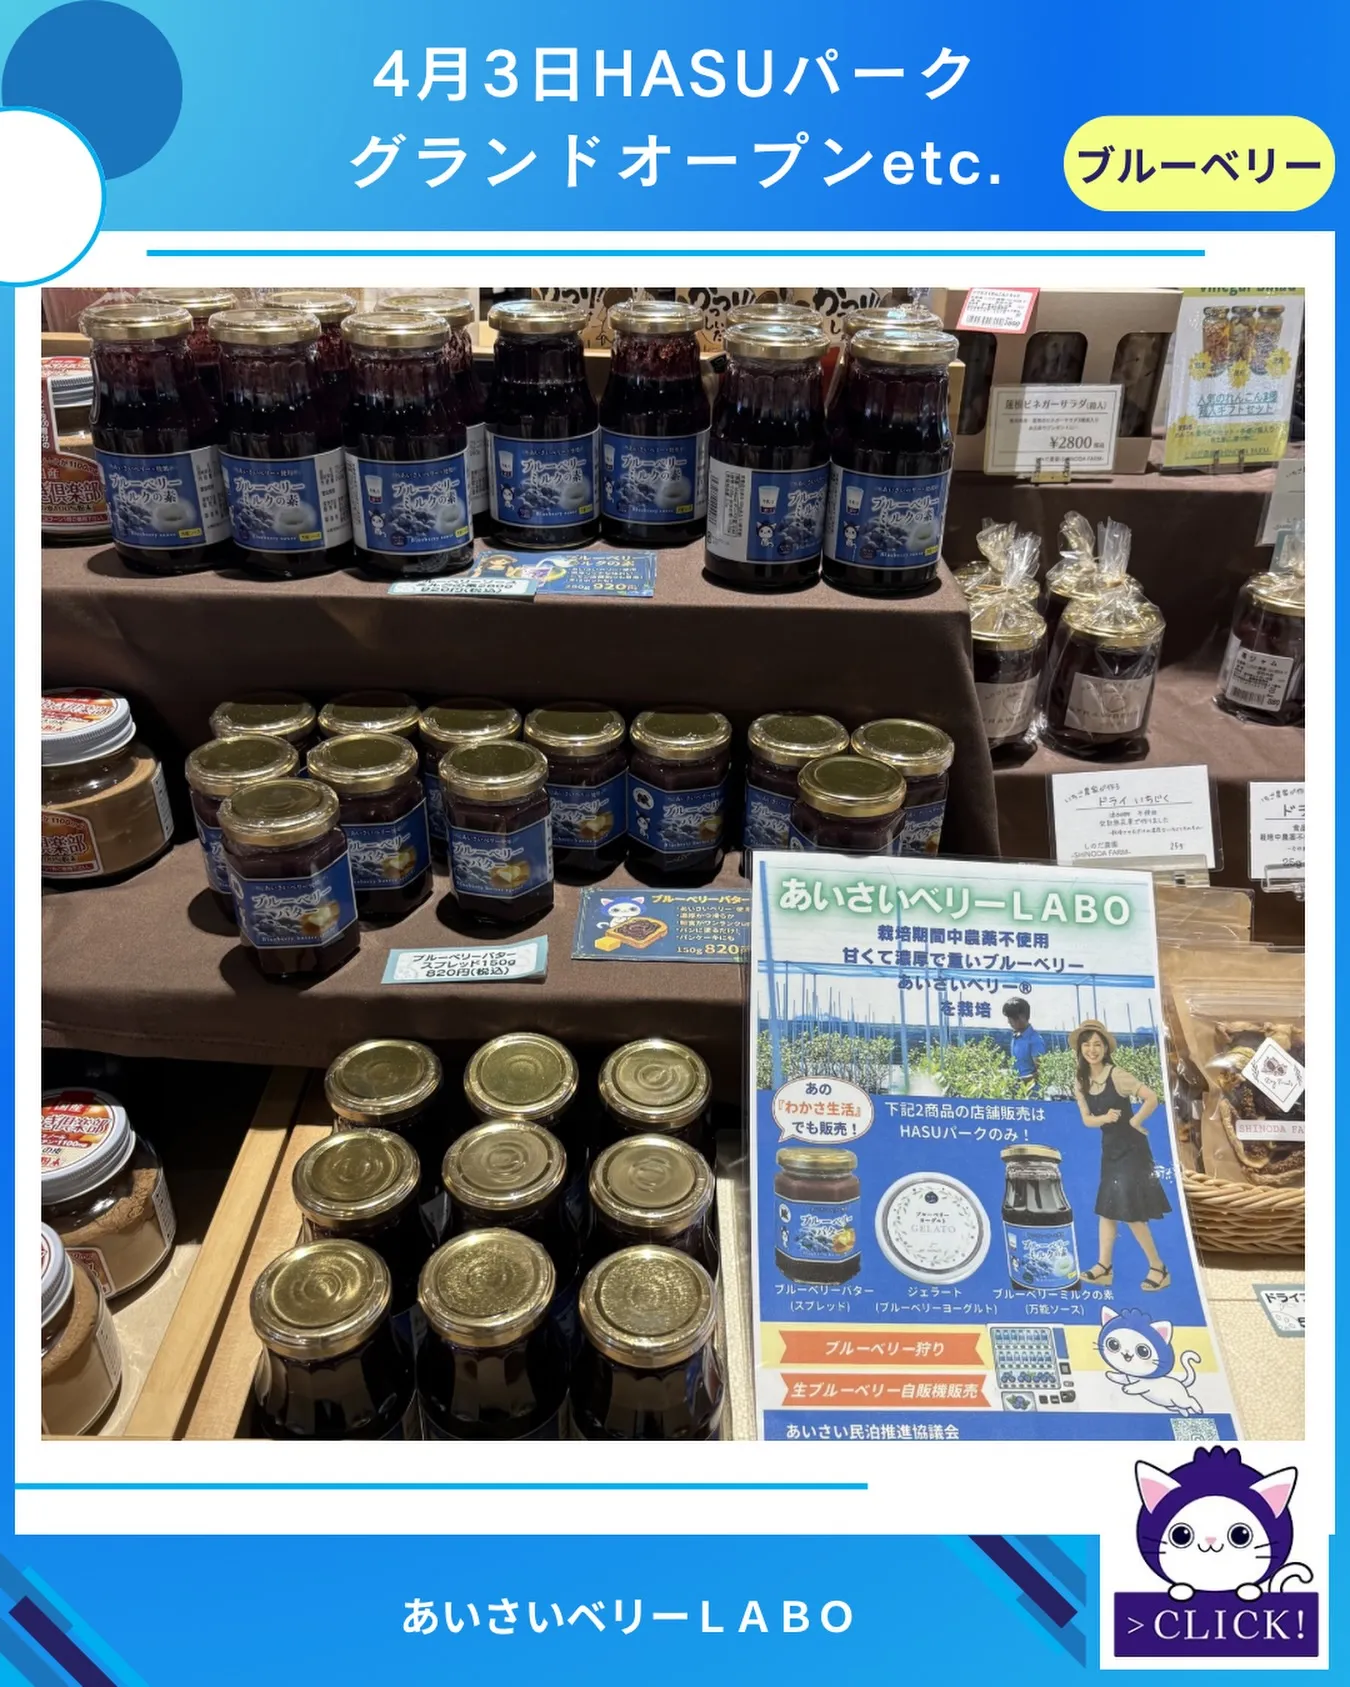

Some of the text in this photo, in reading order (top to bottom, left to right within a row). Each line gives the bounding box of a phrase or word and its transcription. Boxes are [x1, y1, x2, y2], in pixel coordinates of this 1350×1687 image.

[1050, 436, 1092, 449] ¥2800
[521, 457, 586, 473] ブルーベリー
[621, 454, 687, 468] ブルーベリー
[109, 473, 182, 489] ブルーベリー
[233, 477, 305, 492] ブルーベリー
[392, 478, 460, 498] ブルーベリー
[872, 495, 940, 511] ブルーベリー
[1099, 794, 1169, 807] ドライ いちじく
[452, 842, 524, 862] ブルーベリー
[251, 886, 332, 909] ブルーベリー
[778, 878, 1131, 926] あいさいベリーLABO
[276, 906, 319, 920] バター
[877, 924, 1050, 950] 栽培期間中農薬不使用
[413, 951, 516, 962] ブルーベリーバター
[421, 959, 516, 969] スプレッド150g
[842, 947, 1084, 974] 甘くて濃厚で重いブルーベリー
[426, 966, 510, 977] 820円(税込)
[940, 1000, 992, 1019] を栽培
[805, 1082, 832, 1096] あの
[778, 1099, 861, 1118] 『わかさ生活』
[884, 1101, 1045, 1122] 下記2商品の店舗販売は
[1239, 1124, 1286, 1134] SHINODA
[911, 1224, 956, 1234] GELATO
[774, 1284, 1115, 1302] ブルーベリーバター ジェラート ブルーベリーミルクの素
[790, 1300, 850, 1313] (スプレッド)
[875, 1301, 998, 1315] (ブルーベリーヨーグルト)
[824, 1340, 945, 1357] ブルーベリー狩り
[791, 1381, 978, 1400] 生ブルーベリー自販機販売
[786, 1424, 960, 1440] あいさい民泊推進協議会
